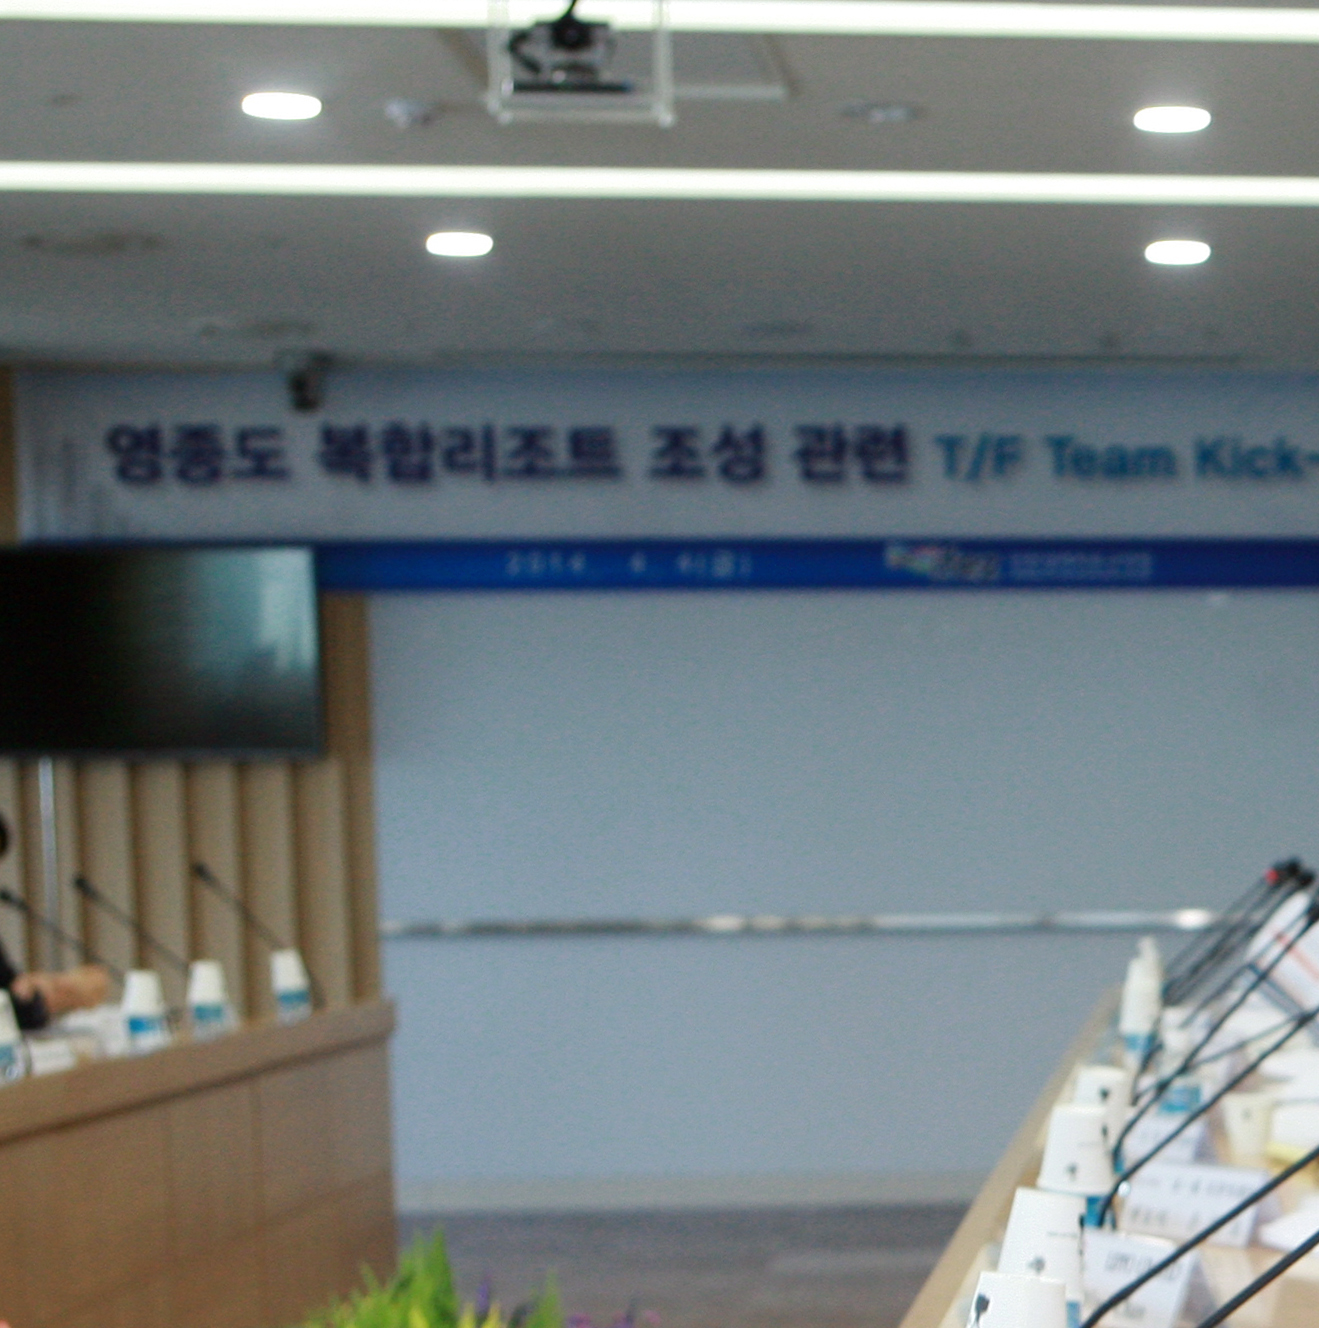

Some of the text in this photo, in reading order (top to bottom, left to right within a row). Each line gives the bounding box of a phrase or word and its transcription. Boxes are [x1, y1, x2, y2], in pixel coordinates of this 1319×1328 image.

[106, 423, 291, 483] 영종도
[317, 423, 624, 484] 복합리조트
[649, 423, 767, 483] 조성
[793, 423, 908, 483] 관련
[935, 432, 1022, 482] T/F
[1047, 433, 1177, 481] Team
